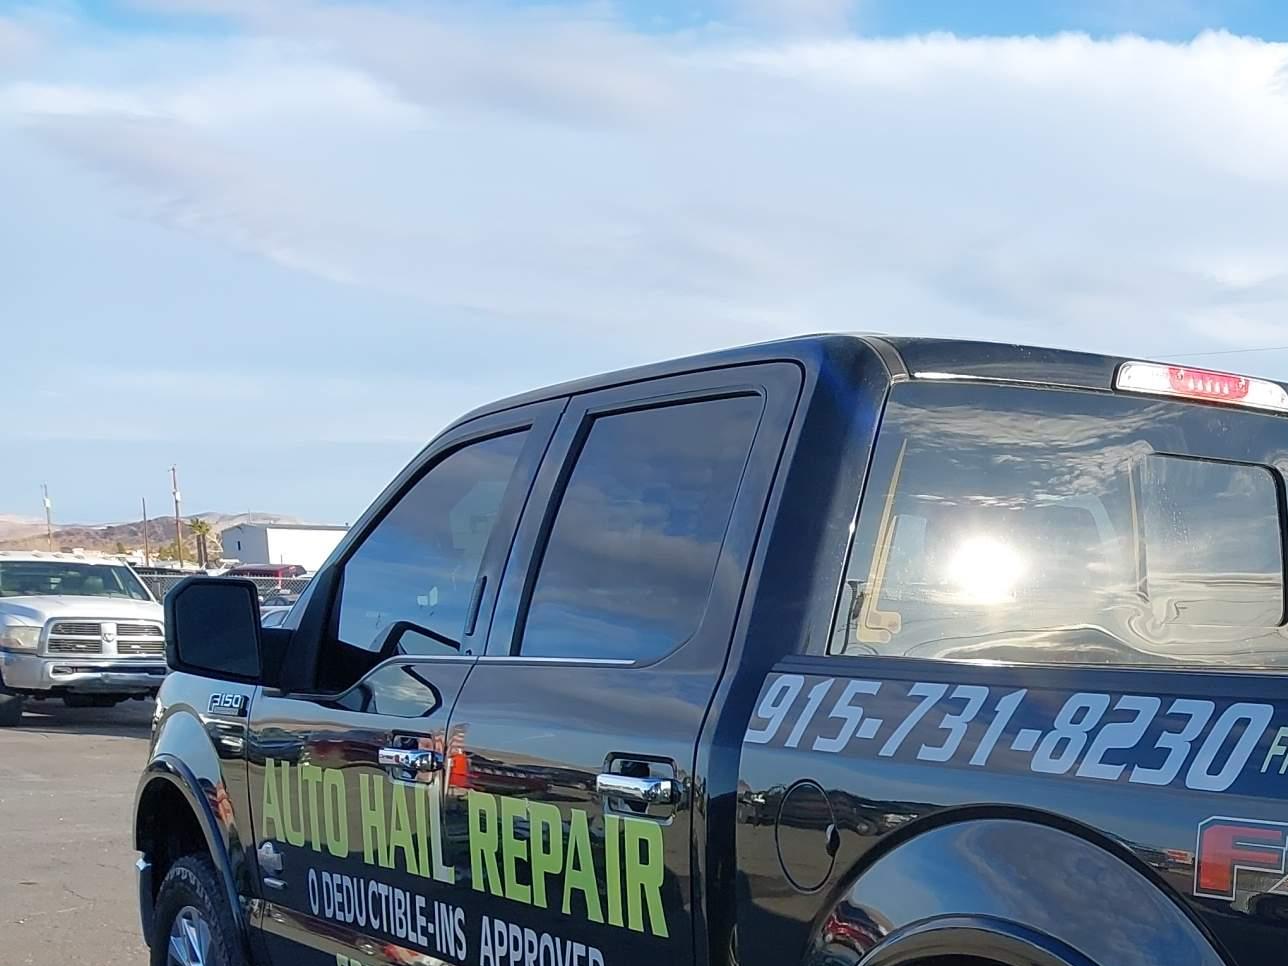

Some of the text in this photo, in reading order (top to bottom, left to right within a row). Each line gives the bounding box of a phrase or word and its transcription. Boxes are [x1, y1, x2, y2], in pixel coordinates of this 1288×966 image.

[744, 674, 1274, 792] 915-731-8230
[262, 757, 669, 938] AUTO HAIL REPAIR
[324, 876, 467, 960] DEDUCTIBLE-INS
